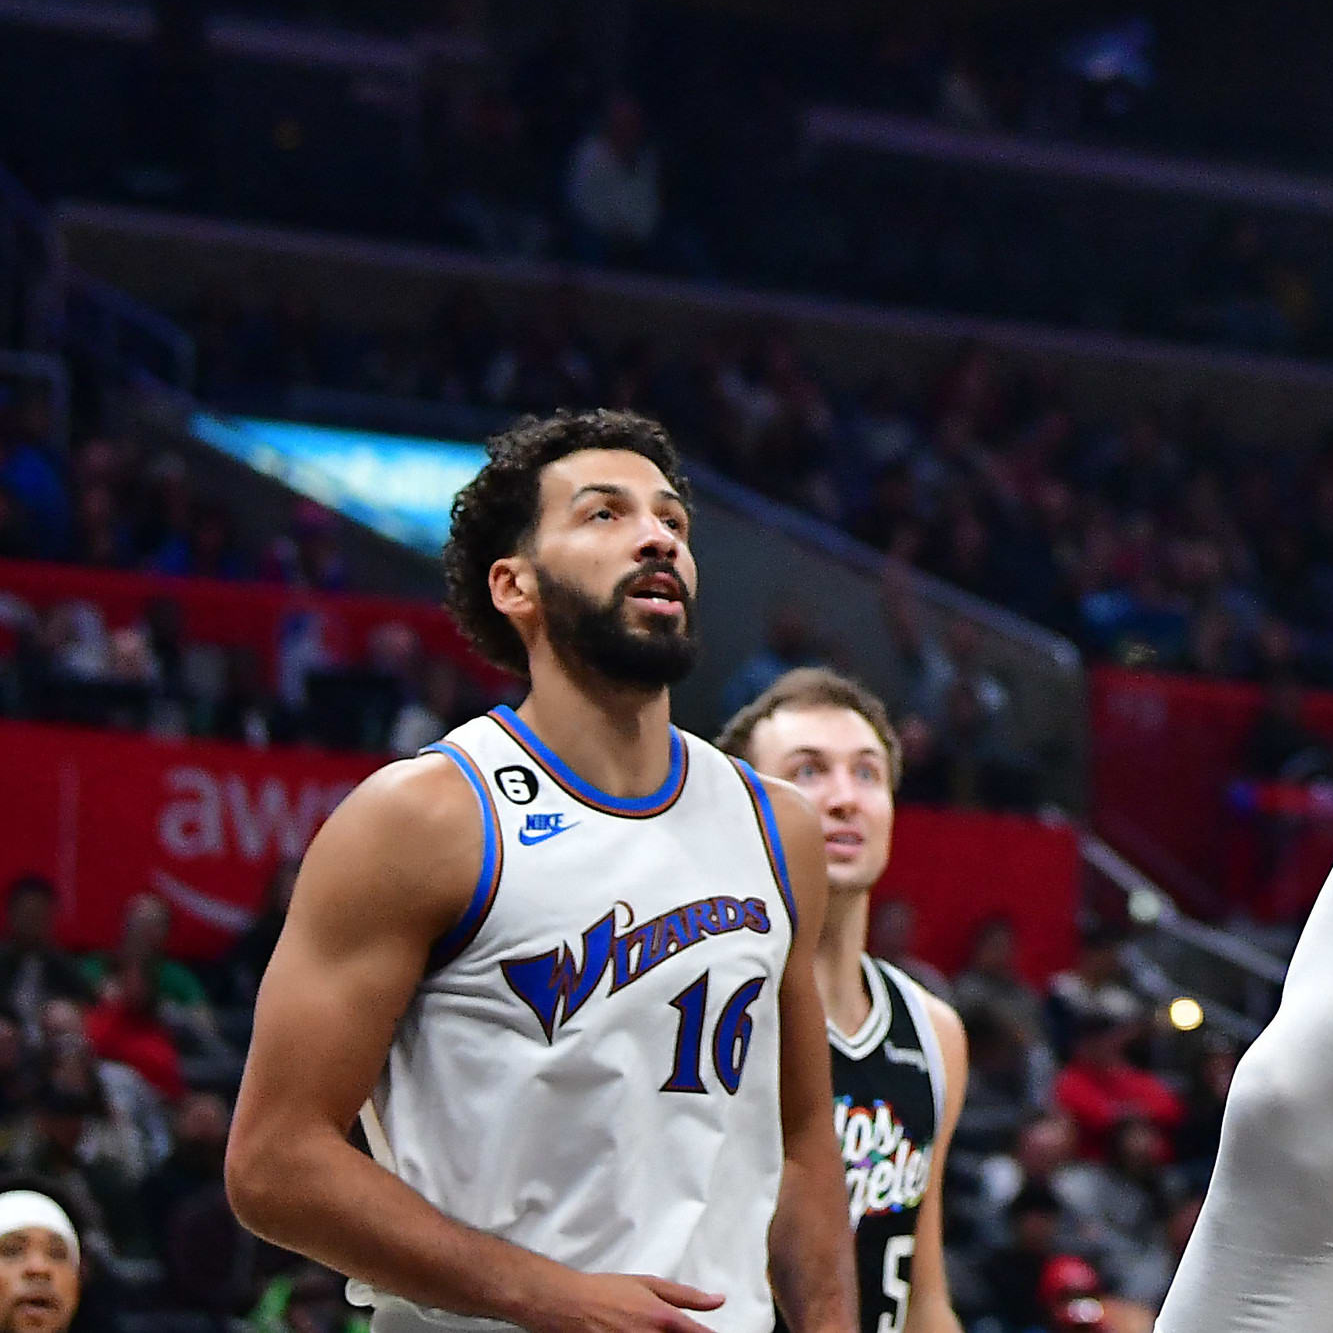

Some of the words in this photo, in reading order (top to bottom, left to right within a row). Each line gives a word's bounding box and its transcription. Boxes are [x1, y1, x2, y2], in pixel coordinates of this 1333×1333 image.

[497, 767, 534, 805] 6
[525, 813, 564, 831] NIKE
[658, 967, 768, 1096] 16
